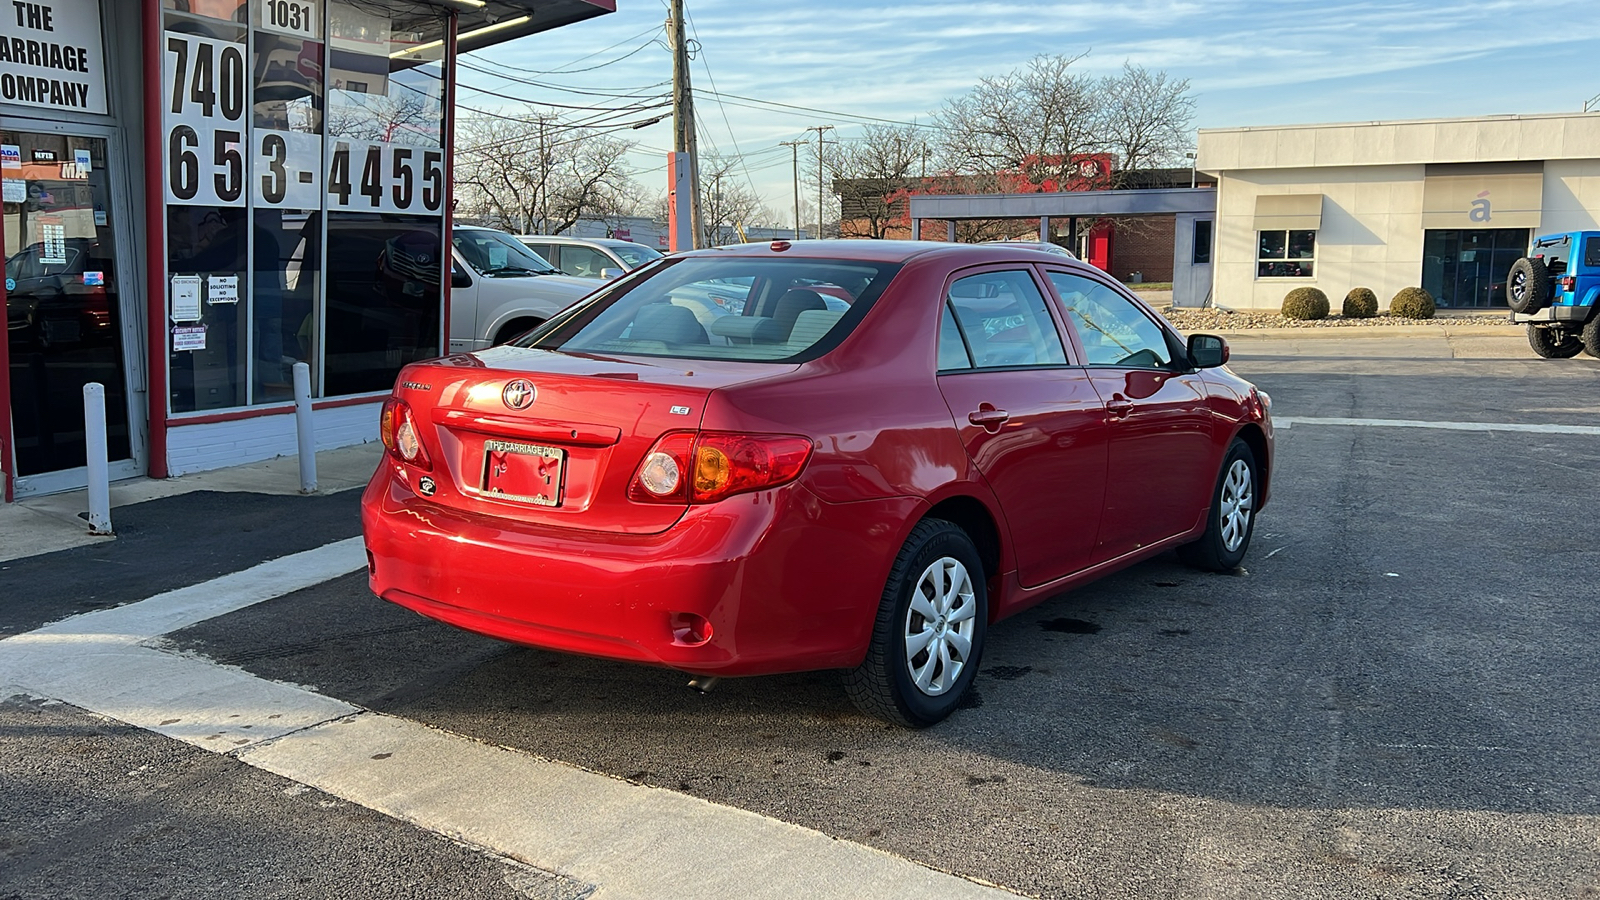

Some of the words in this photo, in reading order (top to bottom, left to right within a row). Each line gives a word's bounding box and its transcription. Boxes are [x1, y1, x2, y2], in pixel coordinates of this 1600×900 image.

[13, 1, 53, 31] THE
[268, 0, 310, 32] 1031
[0, 36, 88, 73] ARRIAGE
[0, 73, 88, 108] OMPANY
[168, 37, 243, 121] 740
[490, 441, 504, 451] THE
[505, 443, 543, 455] CARRIAGE
